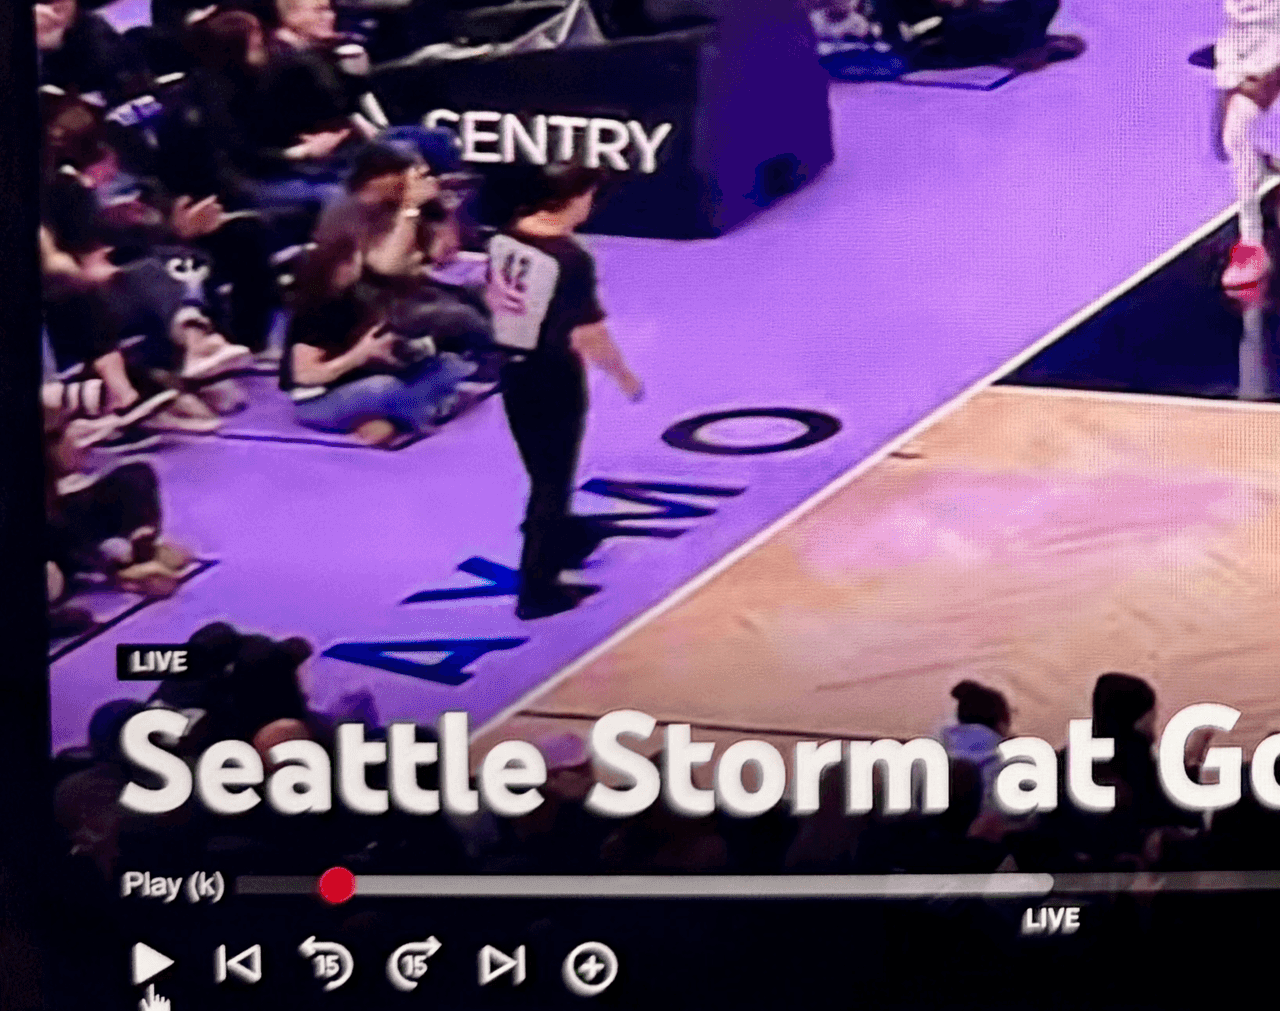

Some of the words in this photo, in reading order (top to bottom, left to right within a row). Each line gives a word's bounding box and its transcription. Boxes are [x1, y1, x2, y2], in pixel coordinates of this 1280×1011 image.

[129, 649, 189, 674] LIVE
[118, 708, 548, 816] Seattle
[587, 708, 951, 816] Storm
[995, 716, 1117, 812] at
[122, 870, 183, 904] Play
[187, 870, 226, 904] (k)
[1022, 906, 1081, 935] LIVE
[311, 954, 341, 979] 15
[399, 954, 429, 978] 15
